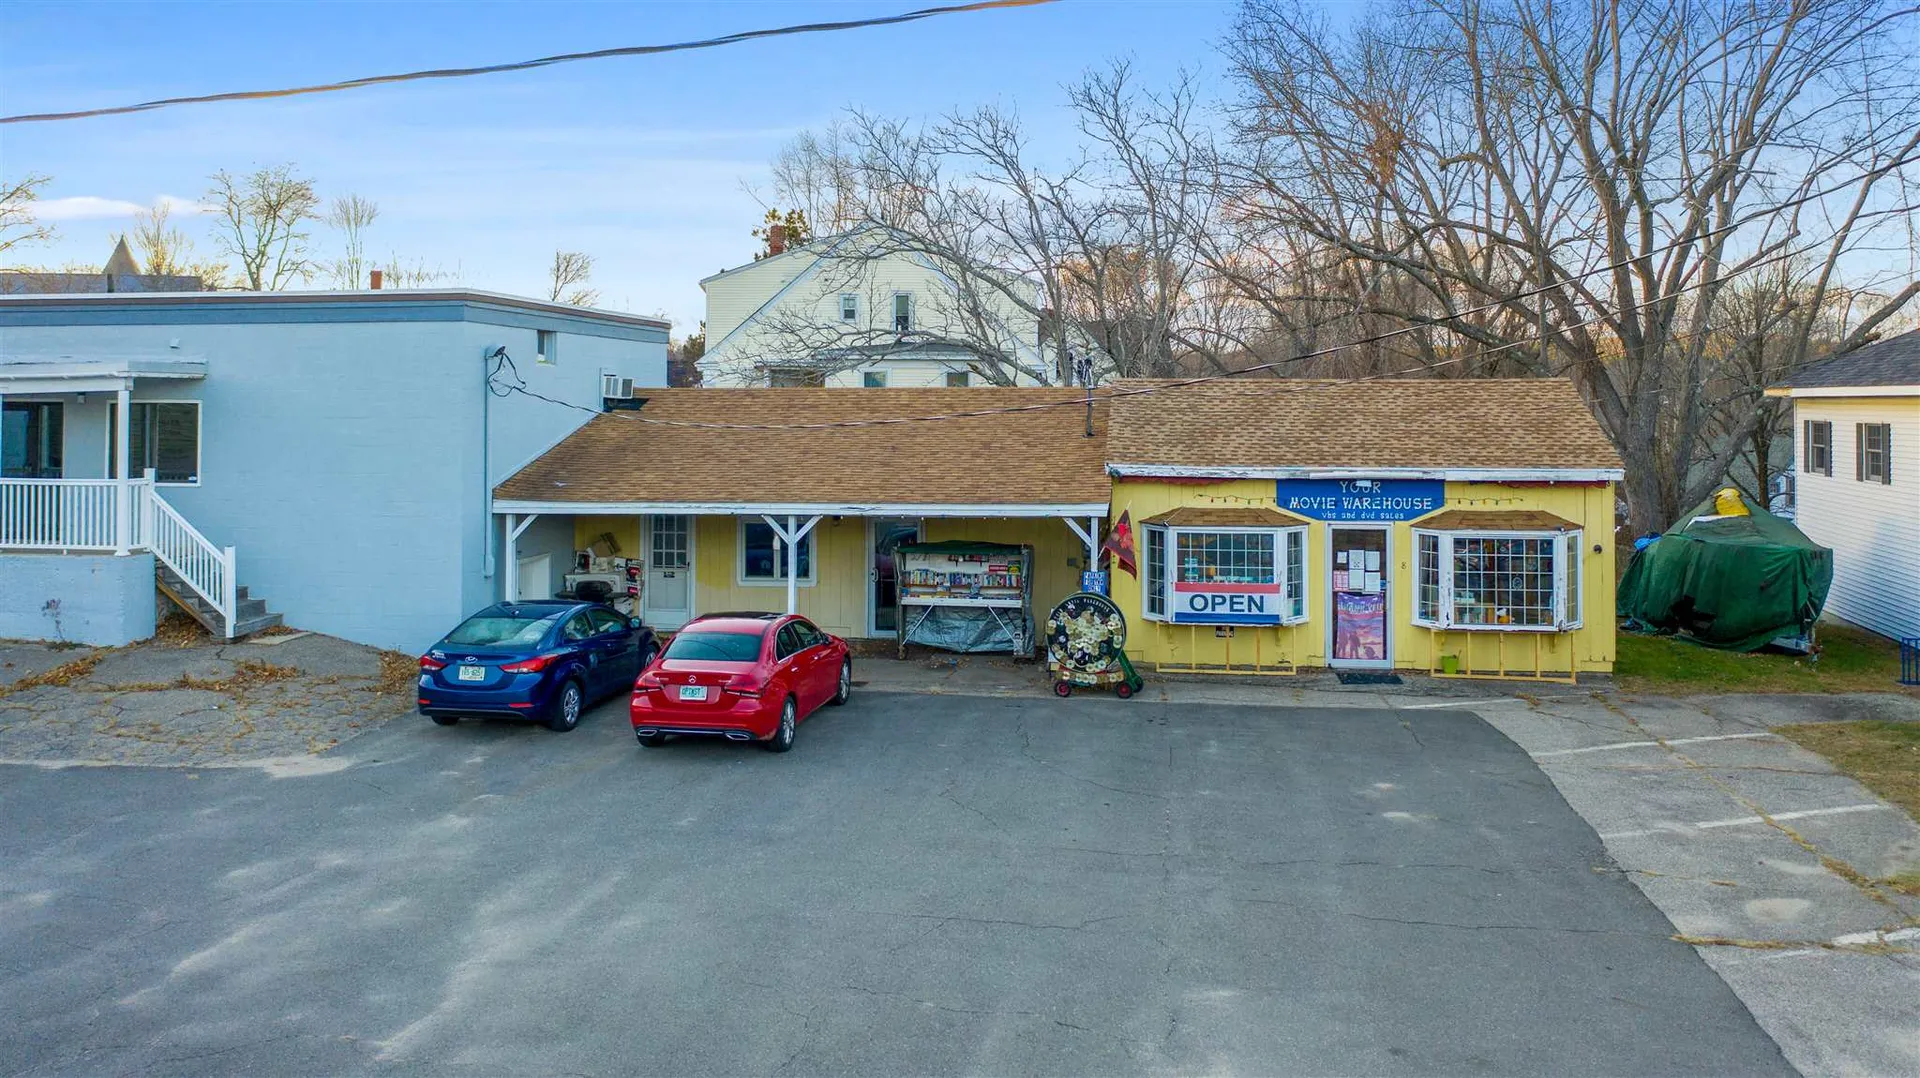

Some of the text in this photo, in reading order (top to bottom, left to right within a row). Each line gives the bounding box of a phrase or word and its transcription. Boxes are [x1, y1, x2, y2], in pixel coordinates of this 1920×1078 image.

[1289, 497, 1432, 510] MOVIE WAREHOUSE
[1189, 594, 1264, 613] OPEN
